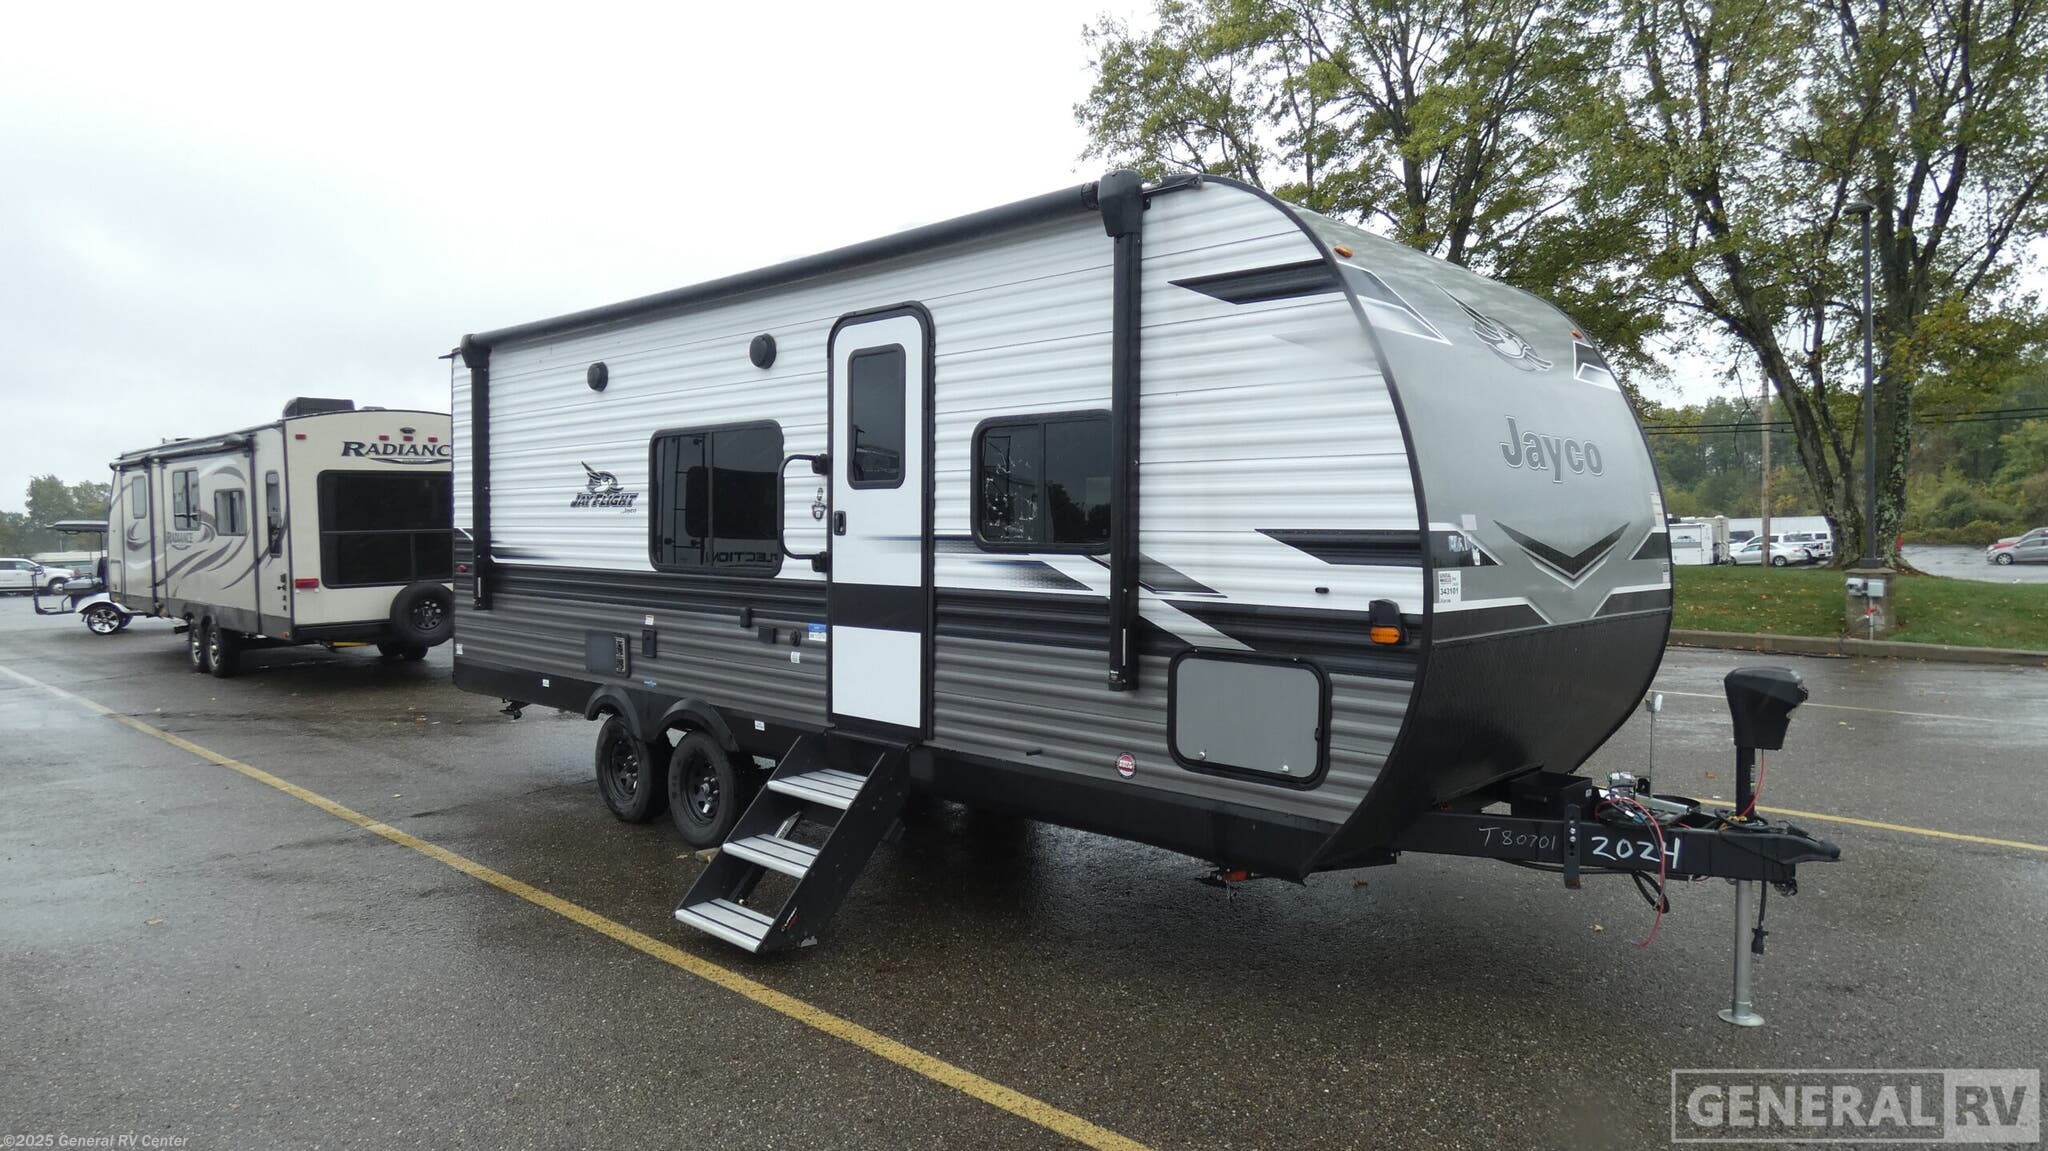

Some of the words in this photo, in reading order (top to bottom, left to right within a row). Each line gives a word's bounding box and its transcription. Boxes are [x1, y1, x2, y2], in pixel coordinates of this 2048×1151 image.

[1499, 415, 1604, 484] Jayco
[570, 492, 594, 508] JAY
[591, 492, 639, 508] FLIGHT
[1591, 836, 1681, 869] 2024
